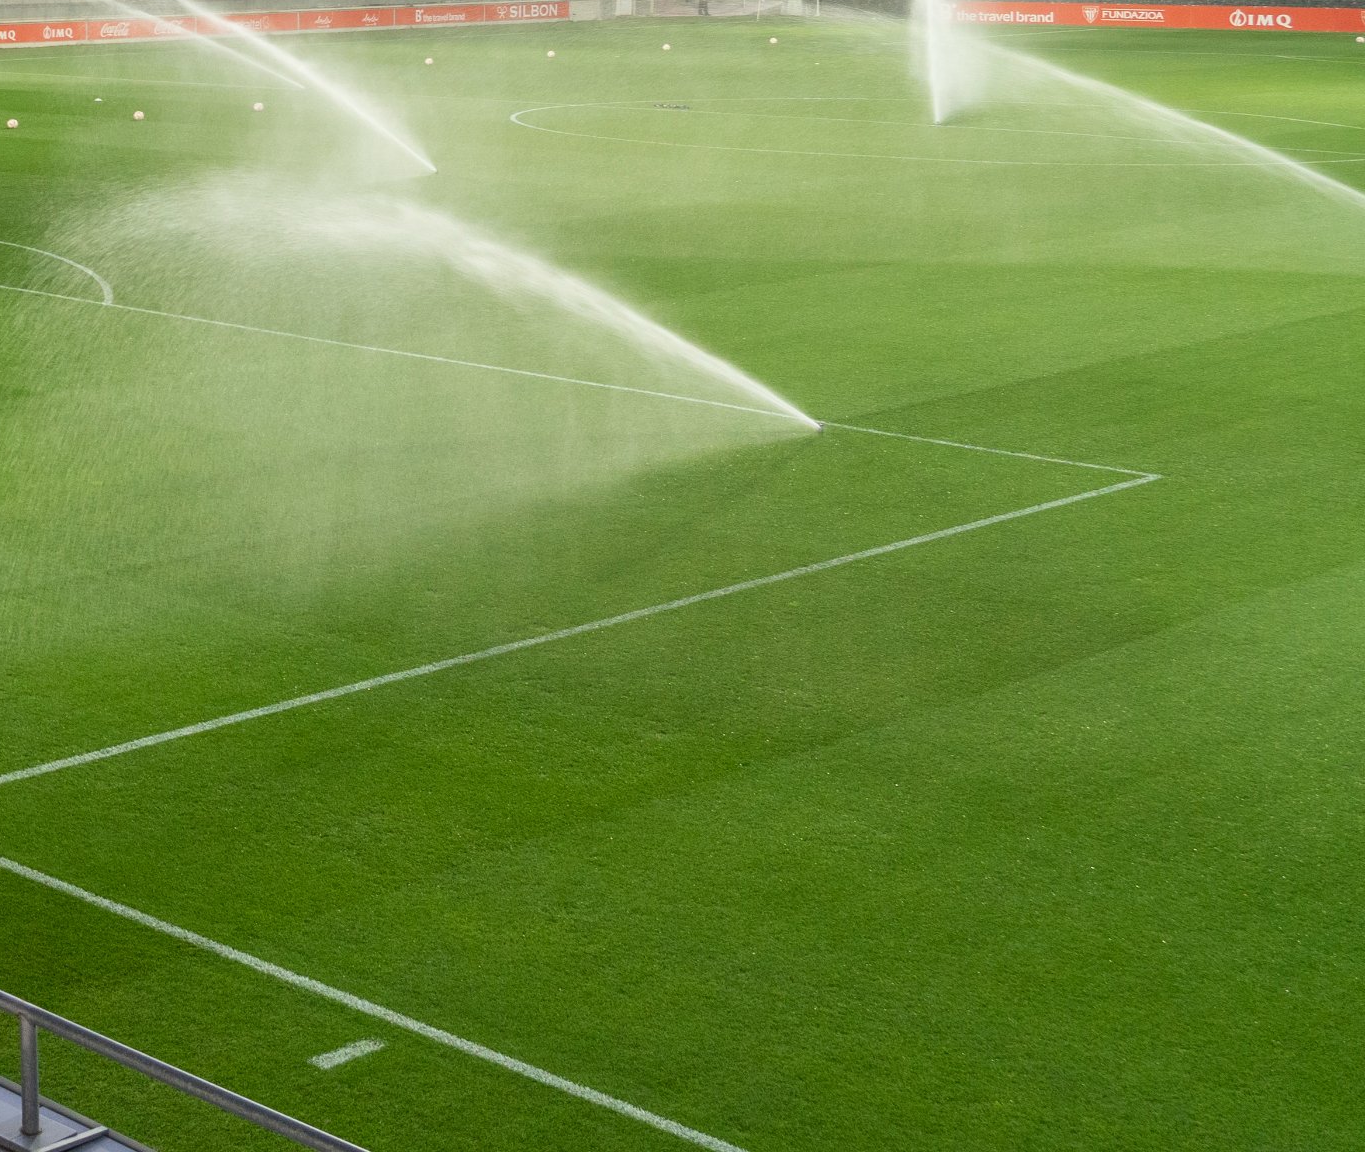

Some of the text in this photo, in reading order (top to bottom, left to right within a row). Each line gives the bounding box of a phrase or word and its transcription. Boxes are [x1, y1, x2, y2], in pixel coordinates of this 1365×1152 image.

[509, 4, 558, 18] SILBON
[956, 10, 976, 22] the
[979, 11, 1014, 22] travel
[1016, 11, 1054, 23] brand
[1101, 10, 1164, 20] FUNDAZIOA
[1247, 14, 1293, 29] IMQ
[51, 27, 74, 39] IMQ
